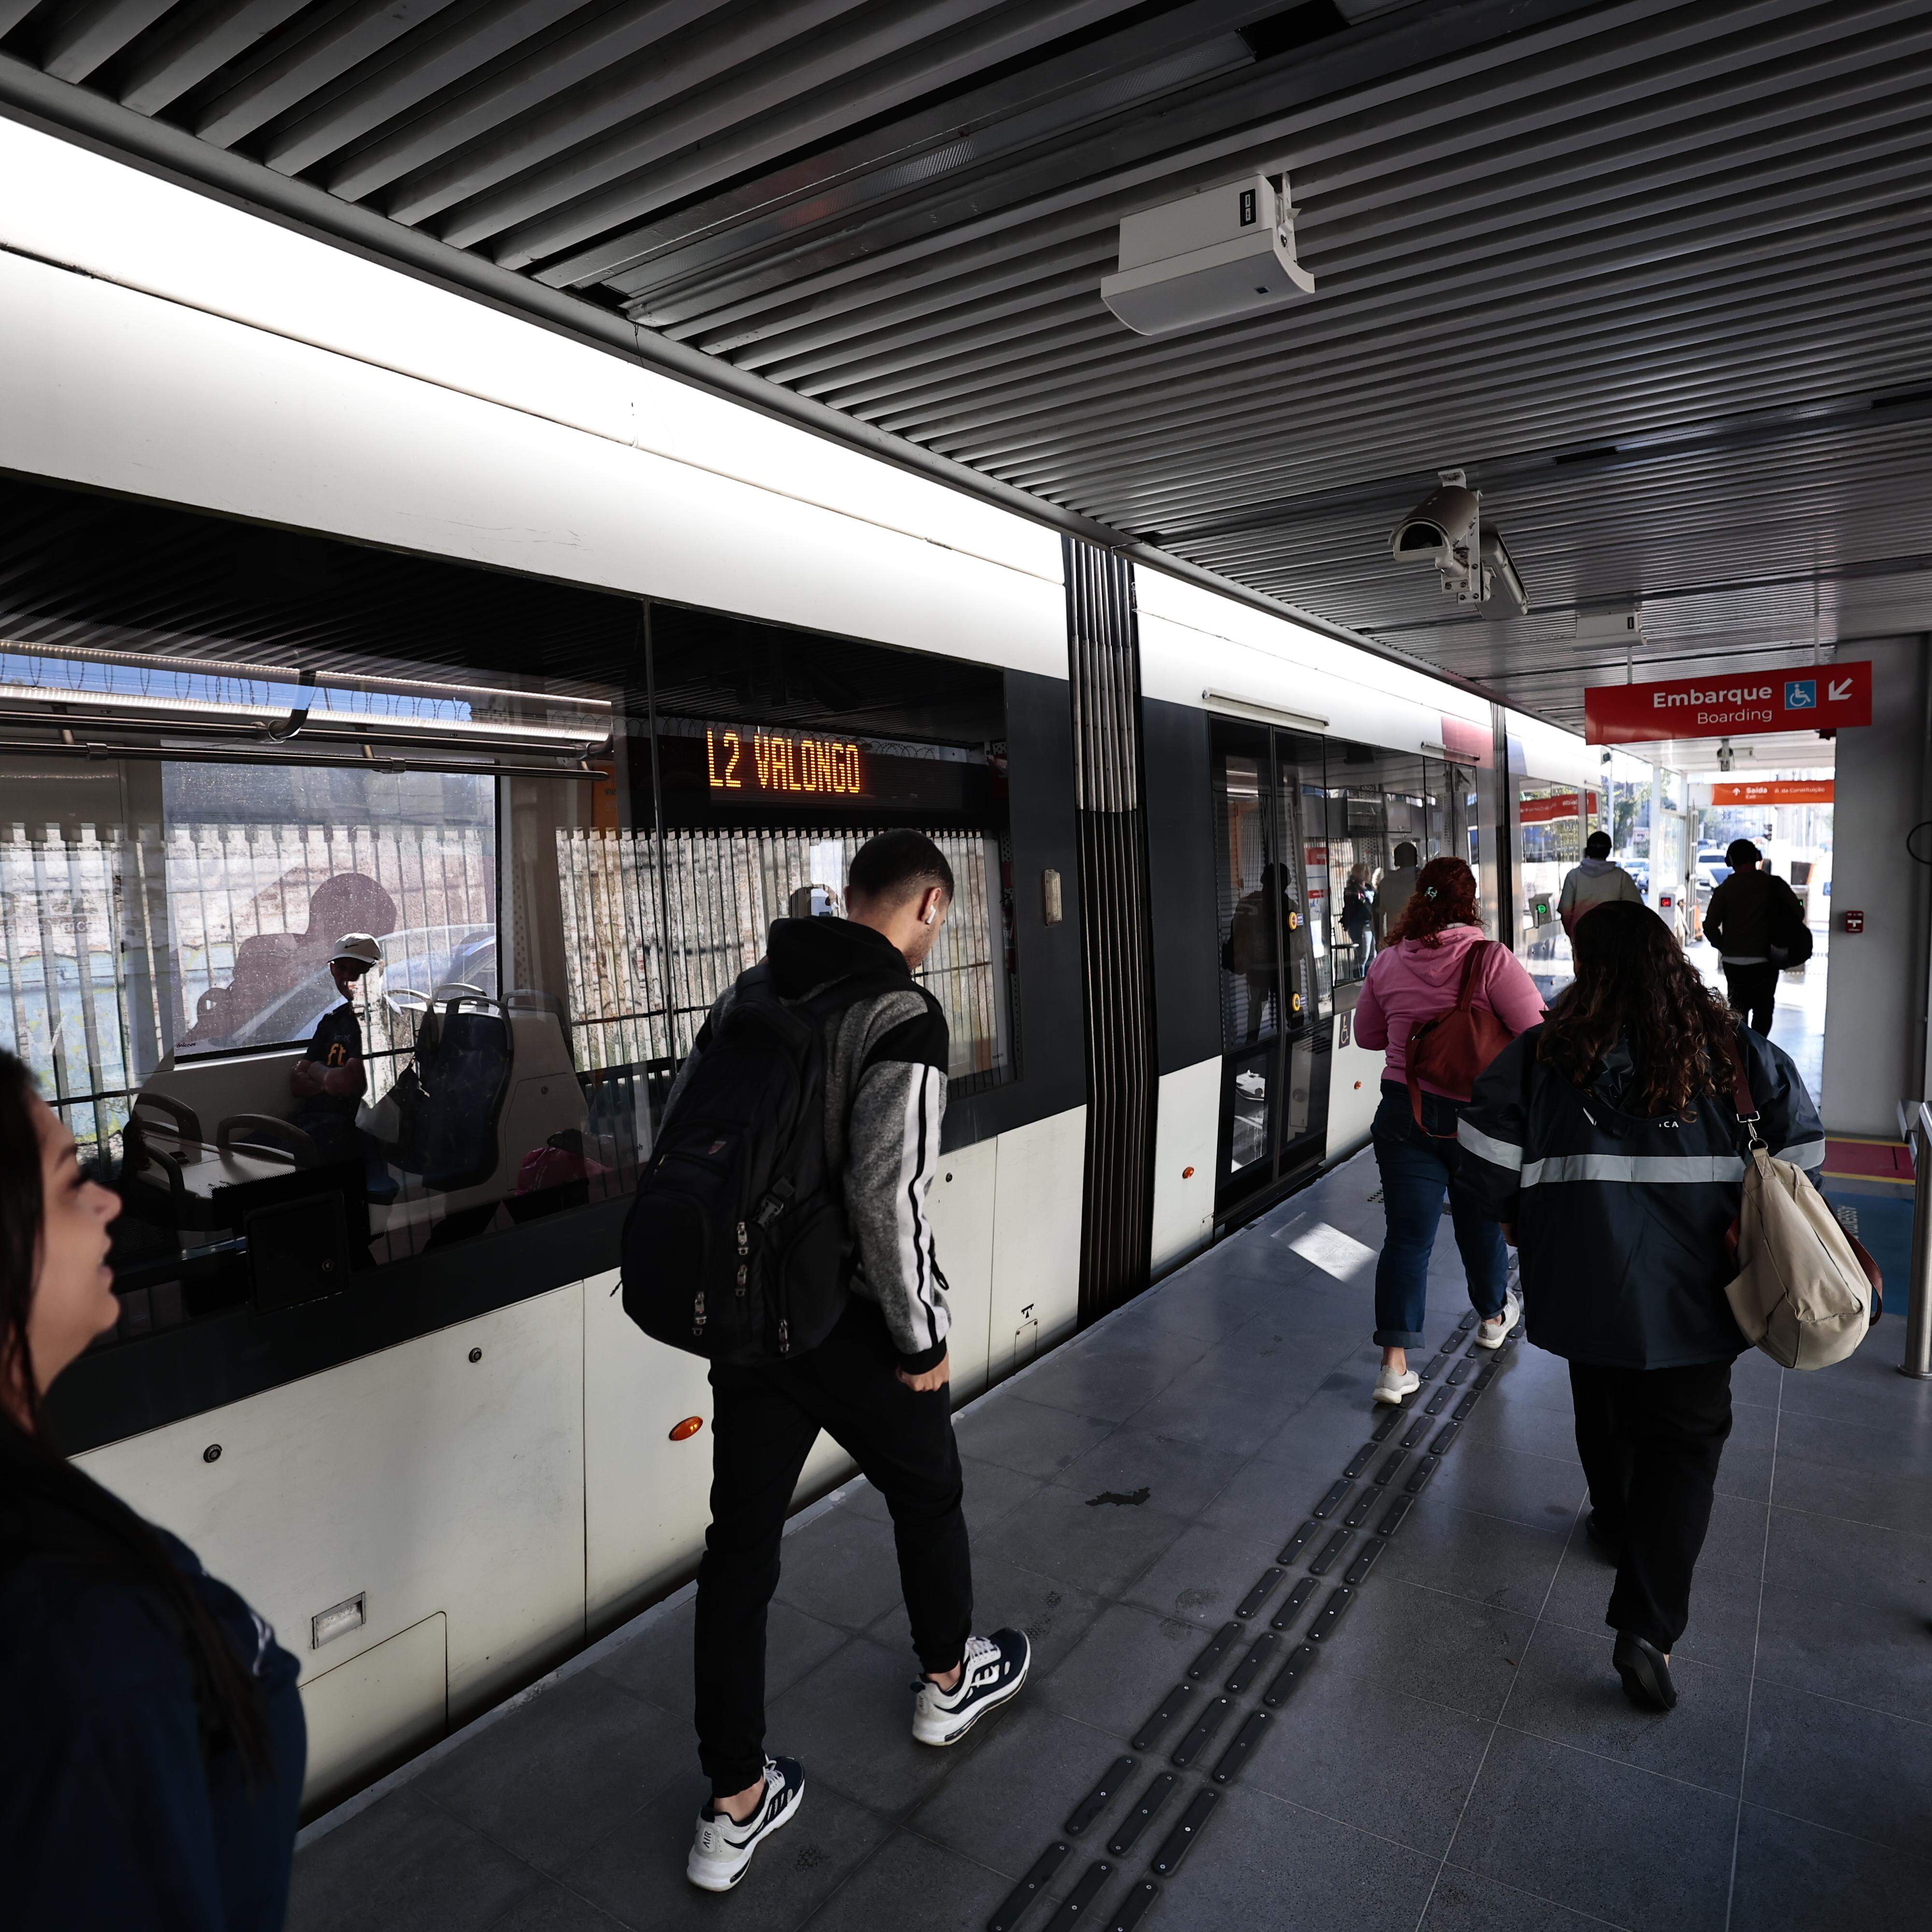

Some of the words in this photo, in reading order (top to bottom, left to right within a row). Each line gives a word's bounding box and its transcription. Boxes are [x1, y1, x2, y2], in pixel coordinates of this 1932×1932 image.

[1653, 686, 1773, 708] Embarque
[1697, 708, 1773, 724] Boarding
[707, 728, 741, 787] L2
[754, 734, 860, 793] VALONGO
[703, 1831, 711, 1849] AIR
